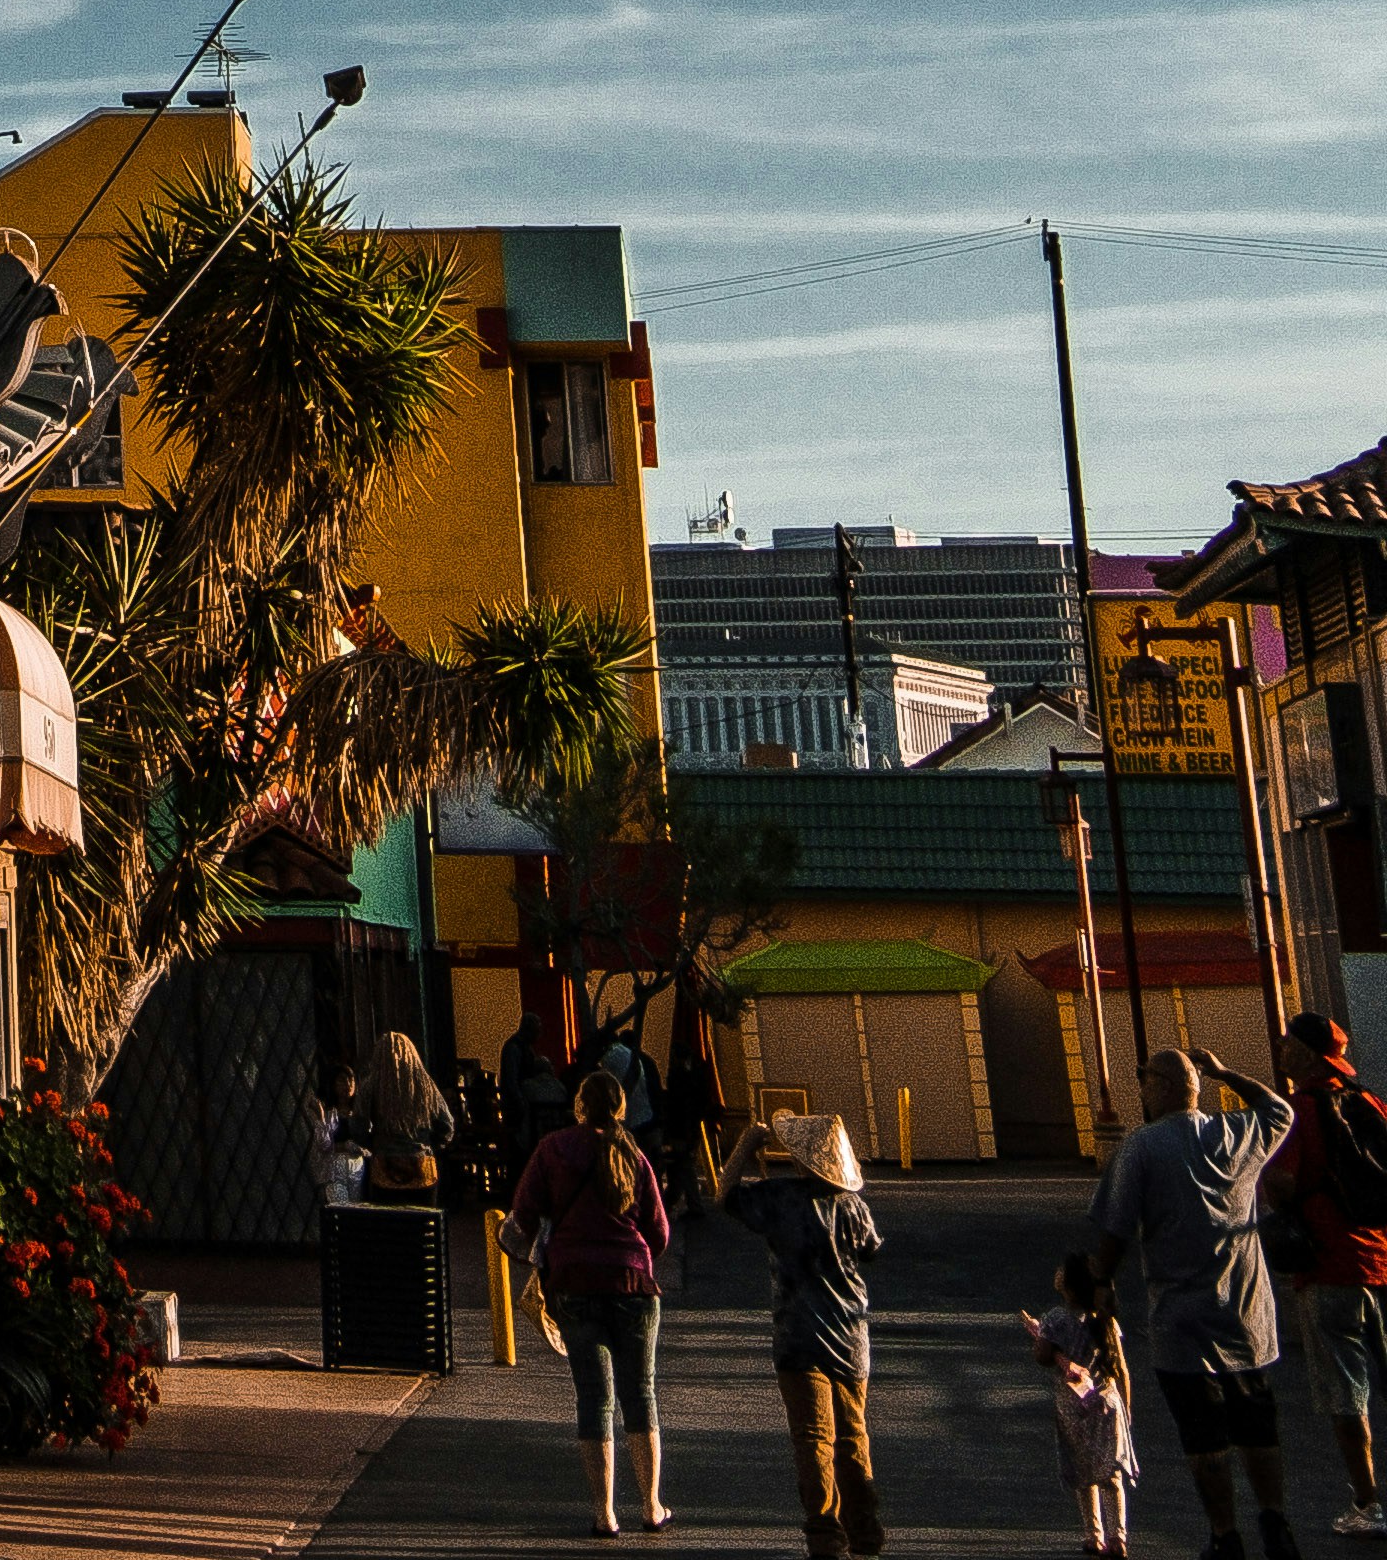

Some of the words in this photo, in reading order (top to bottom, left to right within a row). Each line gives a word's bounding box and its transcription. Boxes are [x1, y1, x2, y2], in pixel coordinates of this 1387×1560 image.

[1170, 655, 1221, 676] SPECI
[1114, 751, 1161, 773] WINE
[1168, 751, 1182, 772] &
[1185, 751, 1233, 773] BEER
